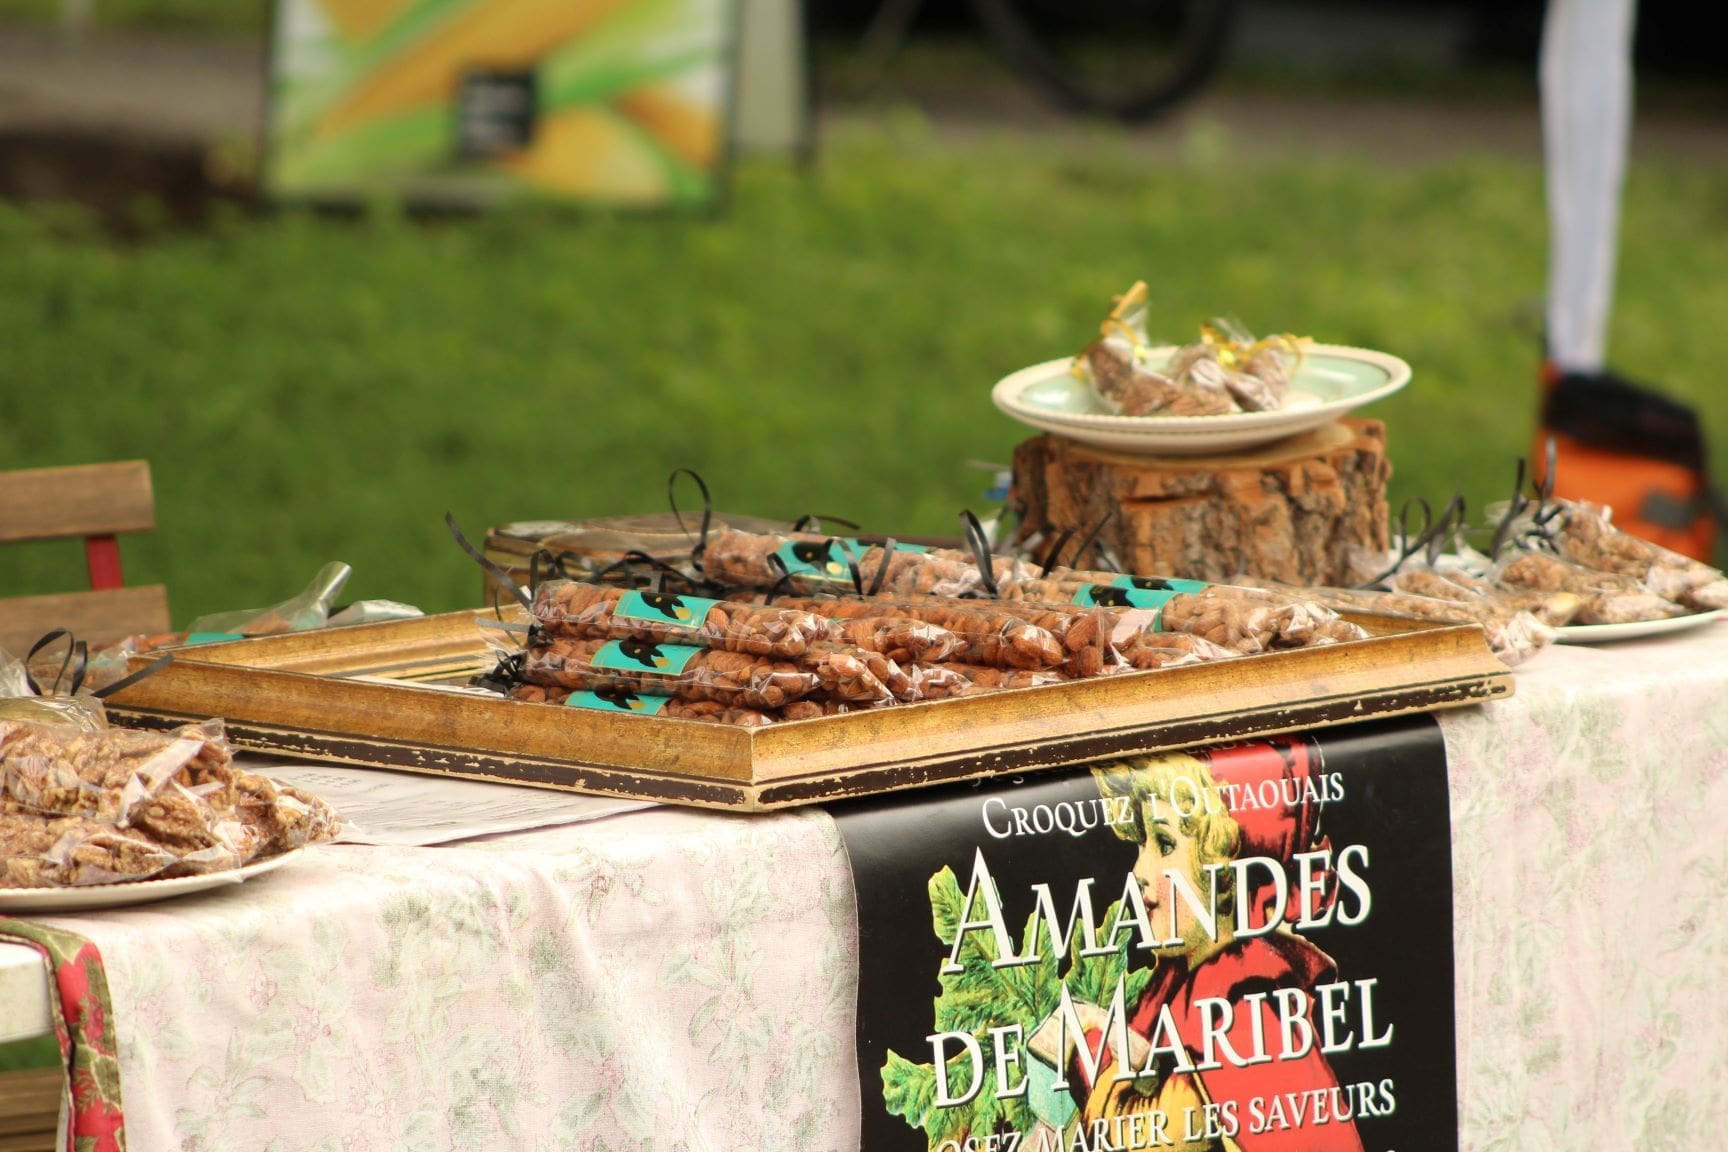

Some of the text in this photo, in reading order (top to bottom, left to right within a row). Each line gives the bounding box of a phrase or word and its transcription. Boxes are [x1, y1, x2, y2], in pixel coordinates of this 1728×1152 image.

[982, 796, 1134, 839] CROQUEZ
[942, 844, 1373, 975] AMANDES
[926, 975, 1395, 1109] DE MARIBEL
[1035, 1109, 1175, 1152] MARIER
[1183, 1100, 1239, 1143] LES
[1249, 1078, 1397, 1134] SAVEURS
